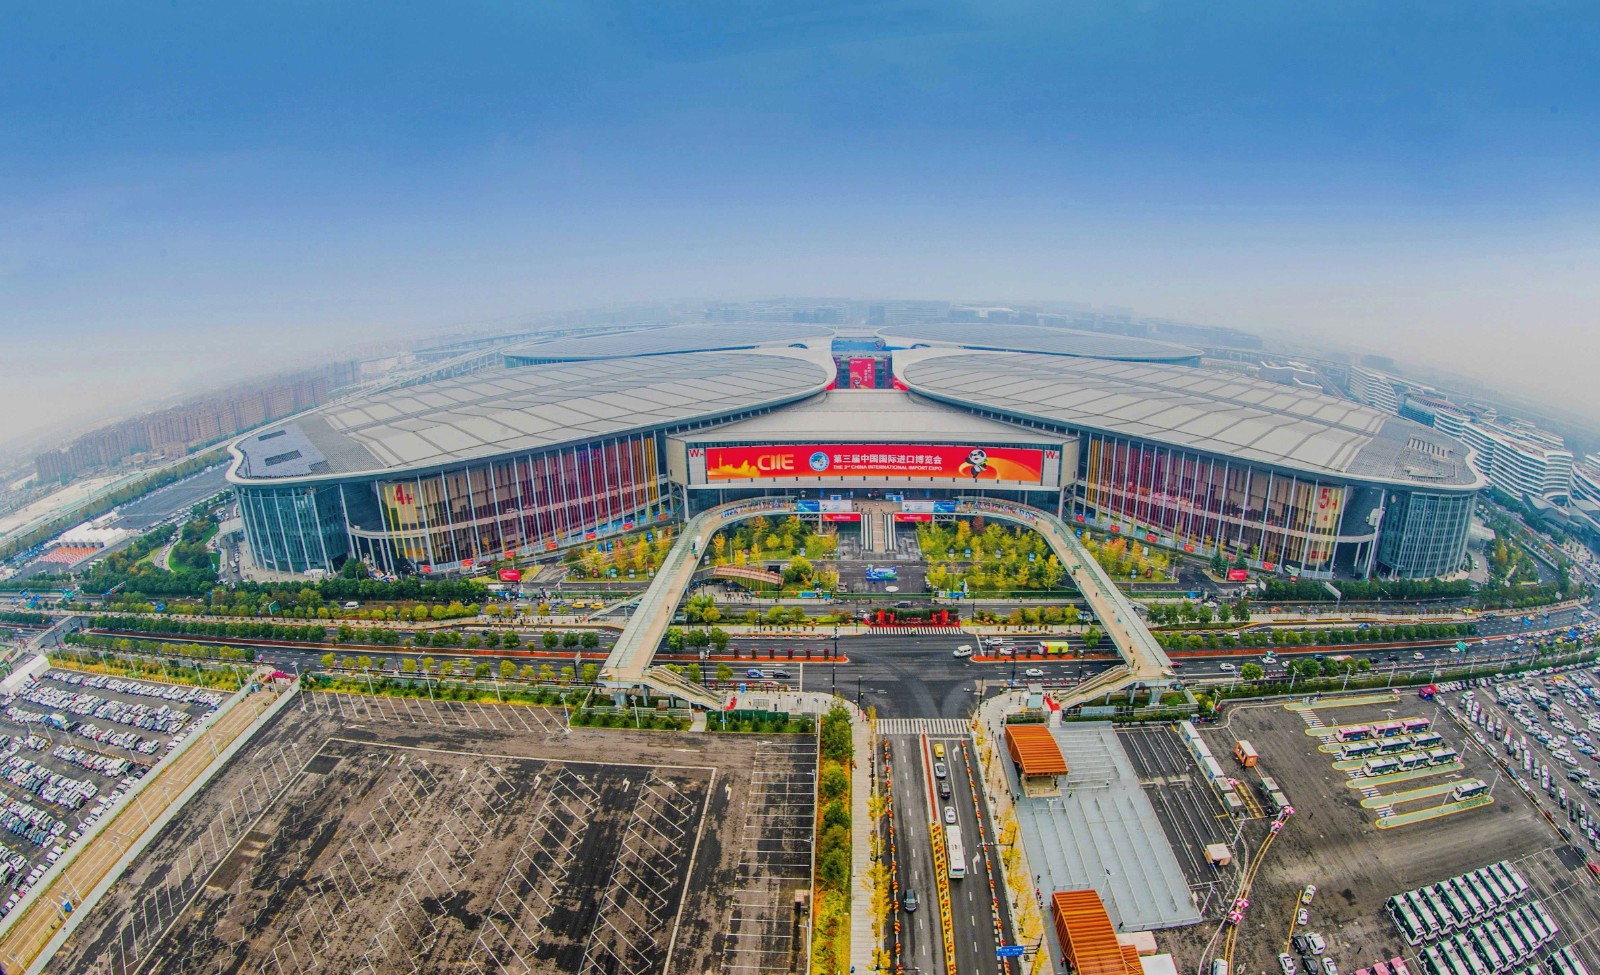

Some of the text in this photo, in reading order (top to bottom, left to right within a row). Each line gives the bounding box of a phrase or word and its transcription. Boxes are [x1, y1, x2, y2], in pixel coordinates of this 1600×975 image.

[757, 454, 795, 470] CIIE
[833, 453, 943, 464] 第三届中国国际进口博览会
